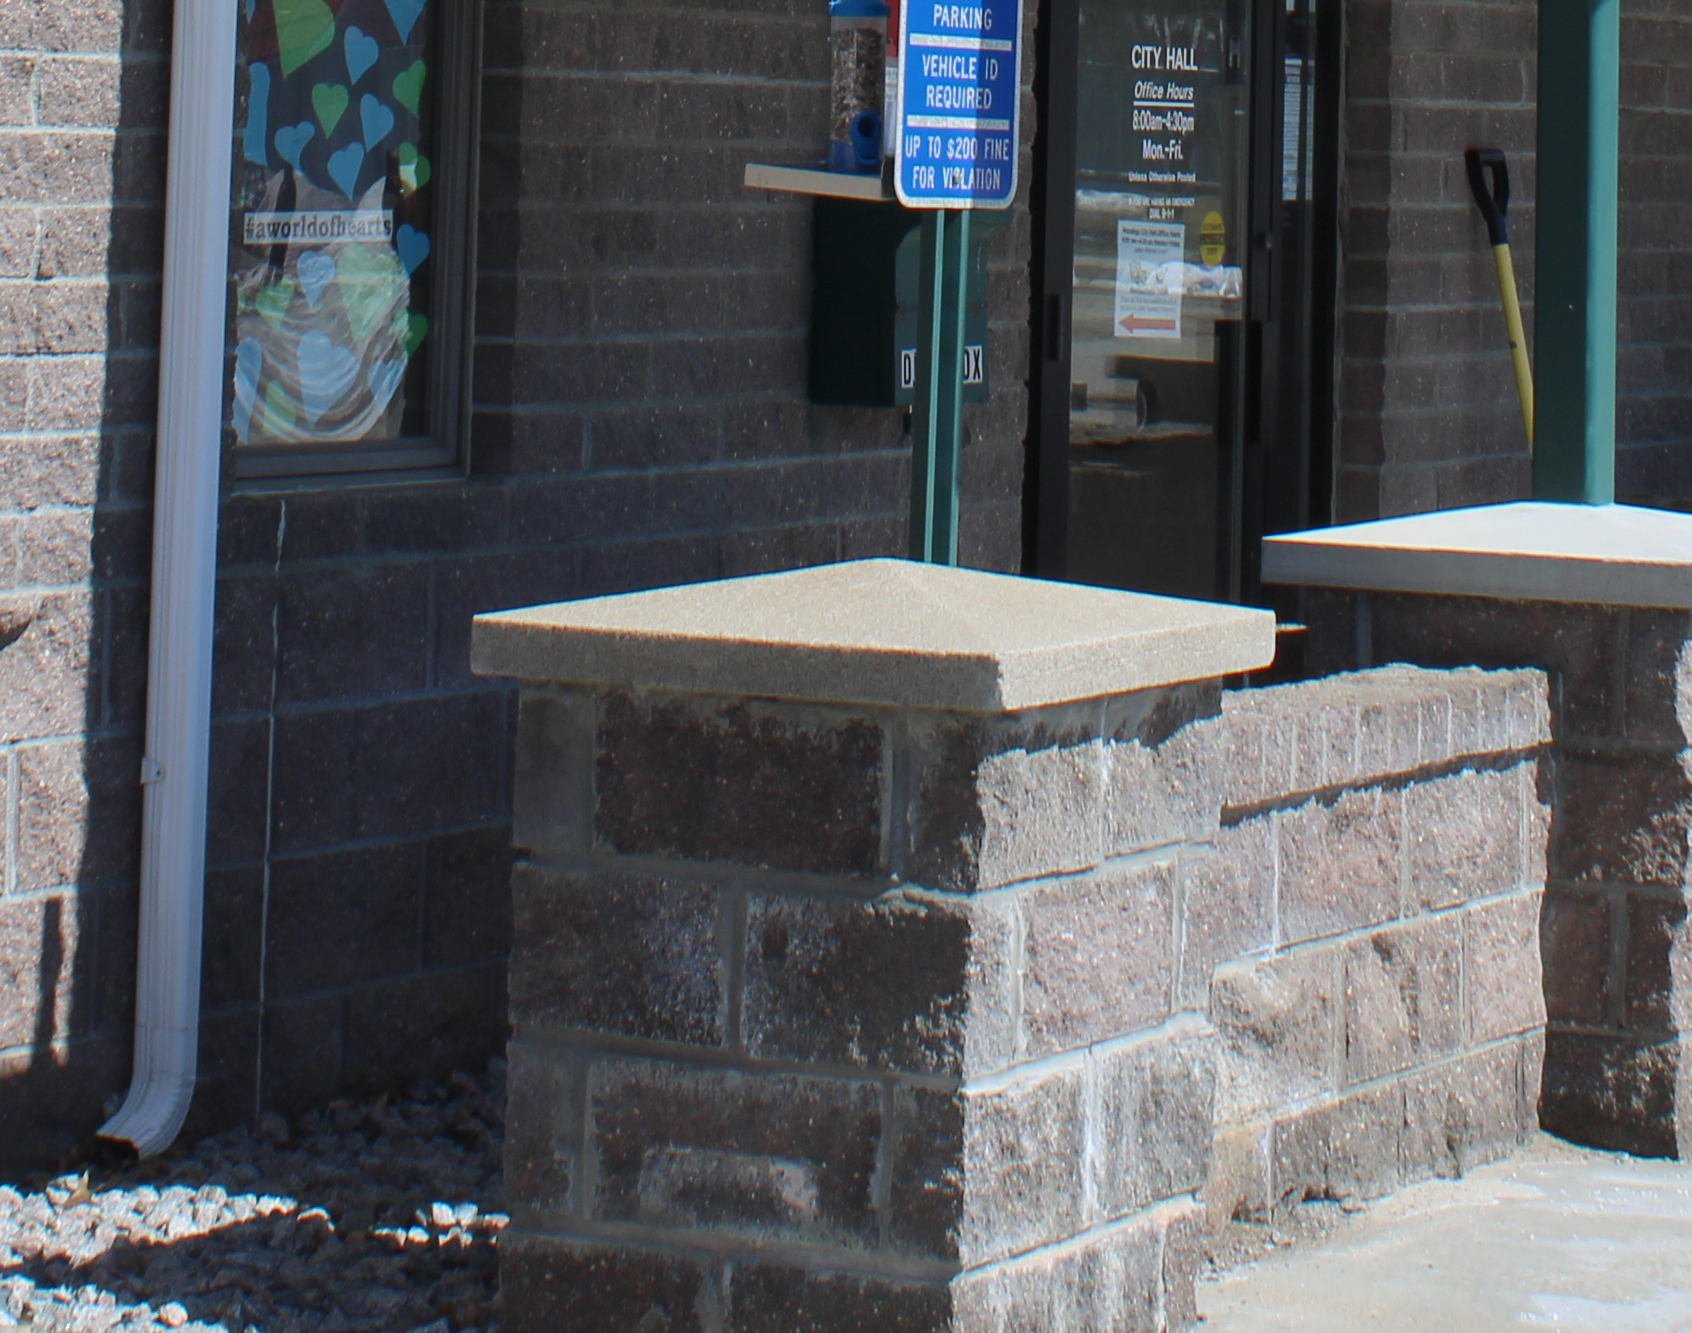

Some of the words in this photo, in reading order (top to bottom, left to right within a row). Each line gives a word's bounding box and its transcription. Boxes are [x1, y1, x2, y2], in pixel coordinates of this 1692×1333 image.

[933, 4, 992, 30] PARKING
[922, 54, 977, 79] VEHICLE
[985, 58, 998, 80] ID
[1132, 45, 1162, 69] CITY
[1166, 47, 1198, 71] HALL
[926, 84, 992, 109] REQUIRED
[1134, 80, 1164, 99] Office
[1166, 82, 1194, 100] Hours
[905, 135, 921, 158] UP
[928, 136, 942, 158] TO
[946, 136, 978, 160] $200
[984, 139, 1010, 161] FINE
[912, 165, 935, 189] FOR
[245, 213, 392, 240] #aworldofhearts
